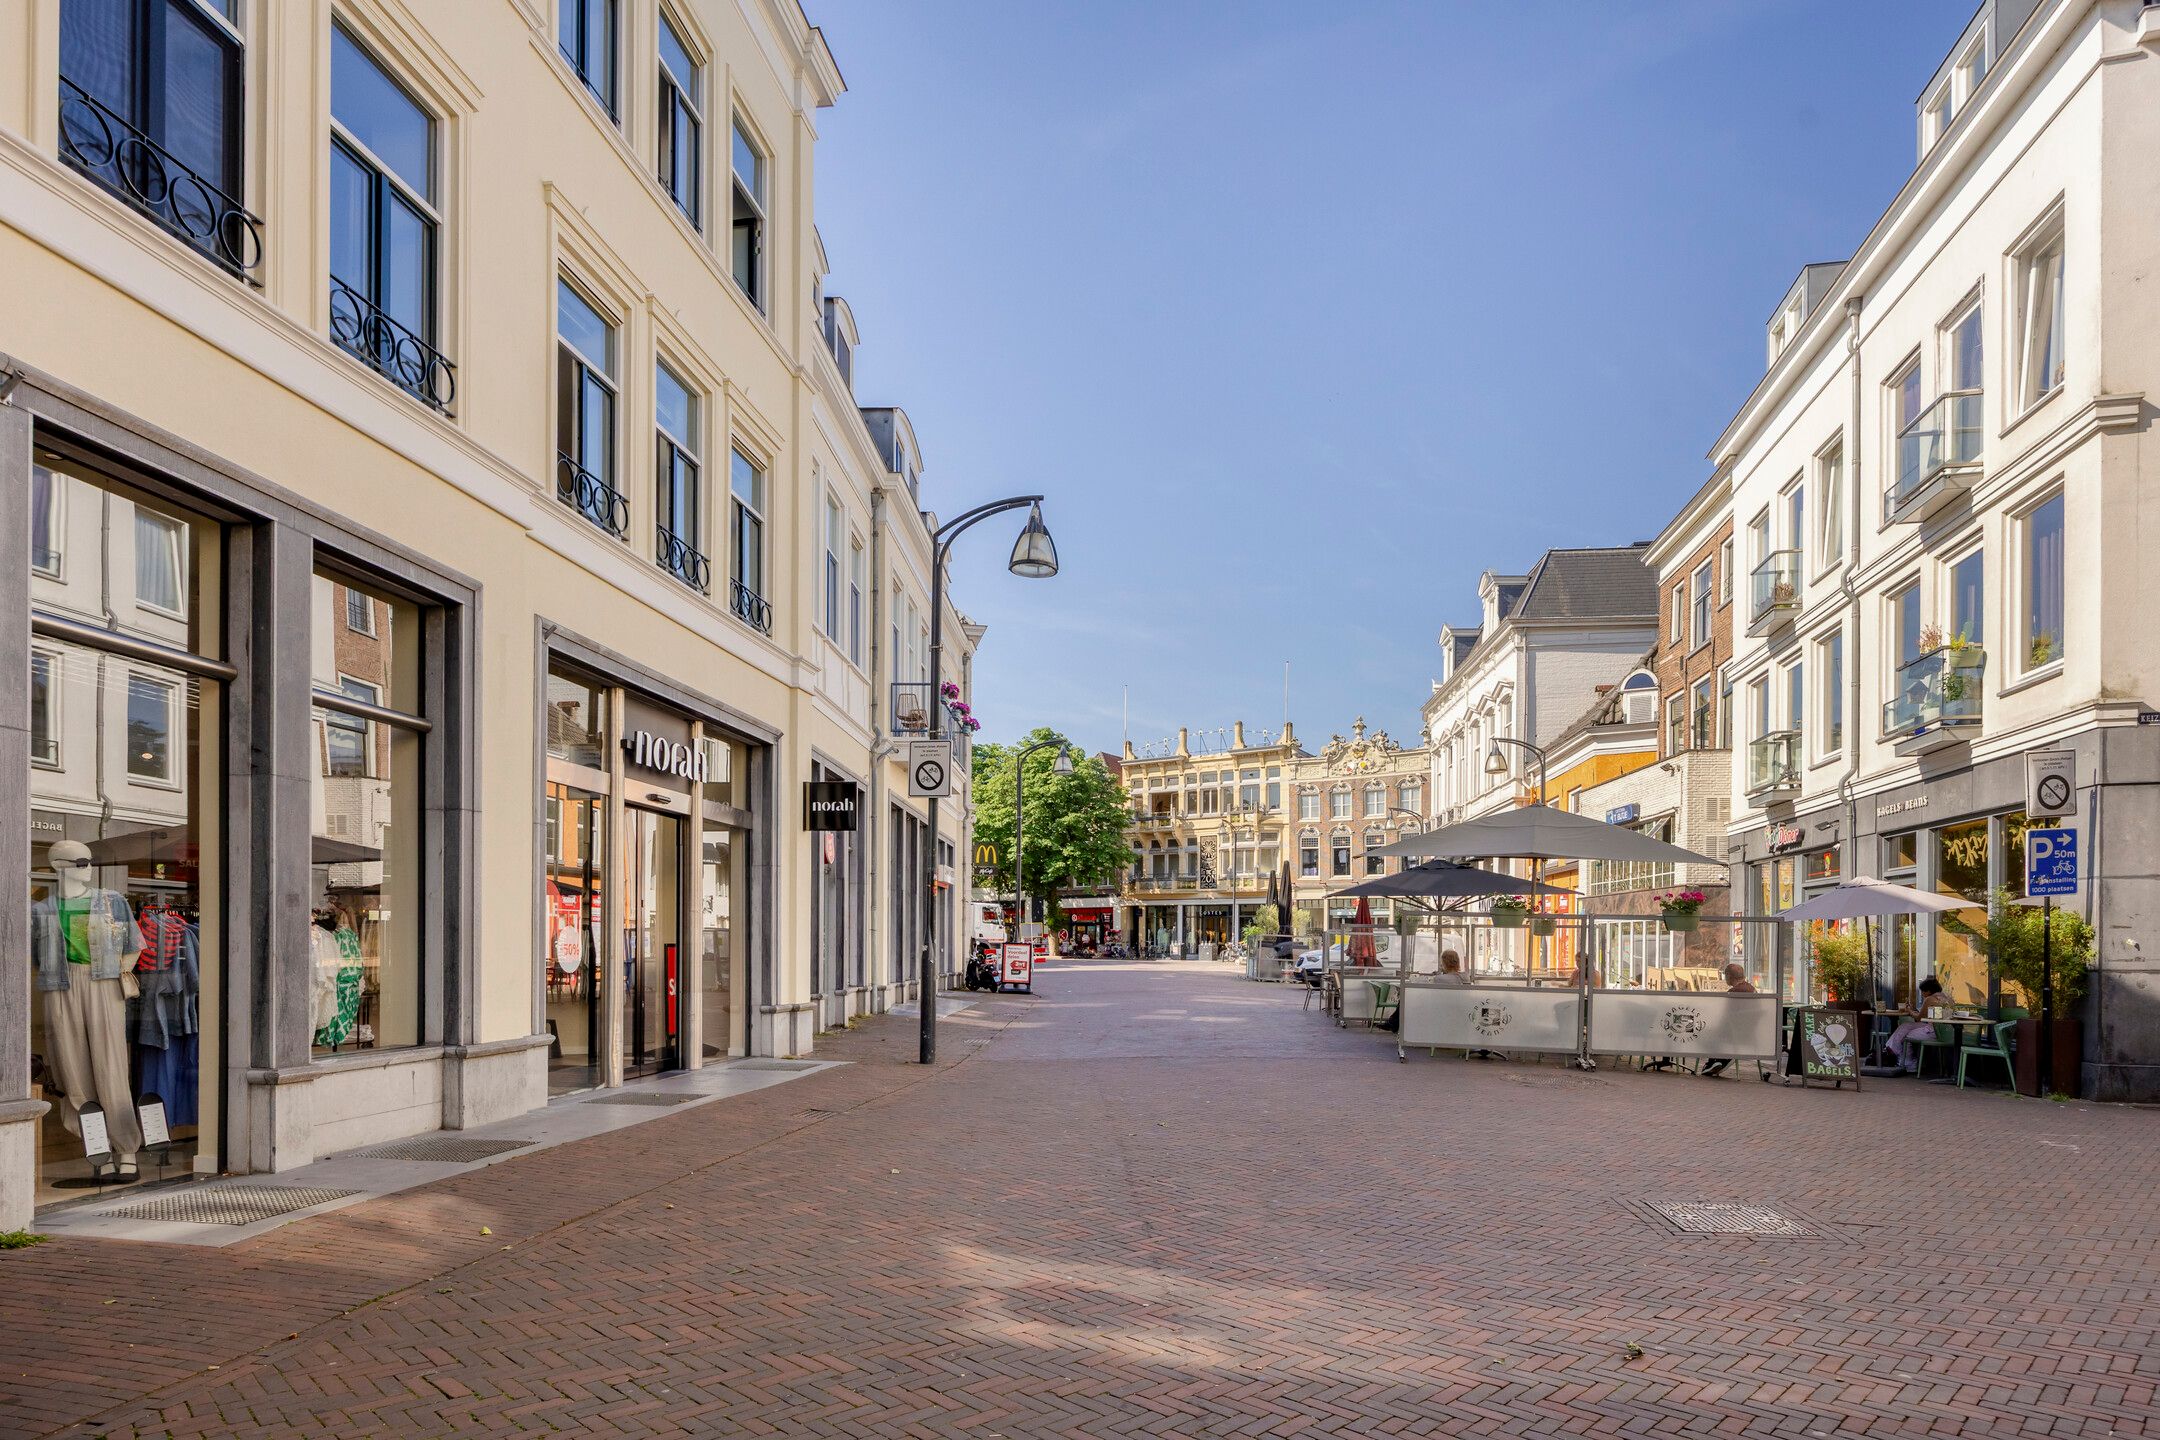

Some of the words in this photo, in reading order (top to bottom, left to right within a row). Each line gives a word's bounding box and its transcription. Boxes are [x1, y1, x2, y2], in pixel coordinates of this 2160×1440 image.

[2140, 714, 2160, 722] KEIZ
[635, 730, 707, 783] norah
[812, 797, 854, 812] norah
[1876, 802, 1902, 817] BAGELS
[1904, 795, 1929, 811] BEANS
[2030, 837, 2053, 871] P
[2054, 850, 2075, 858] 50m
[178, 859, 199, 868] SAL
[1807, 1061, 1851, 1076] BAGELS
